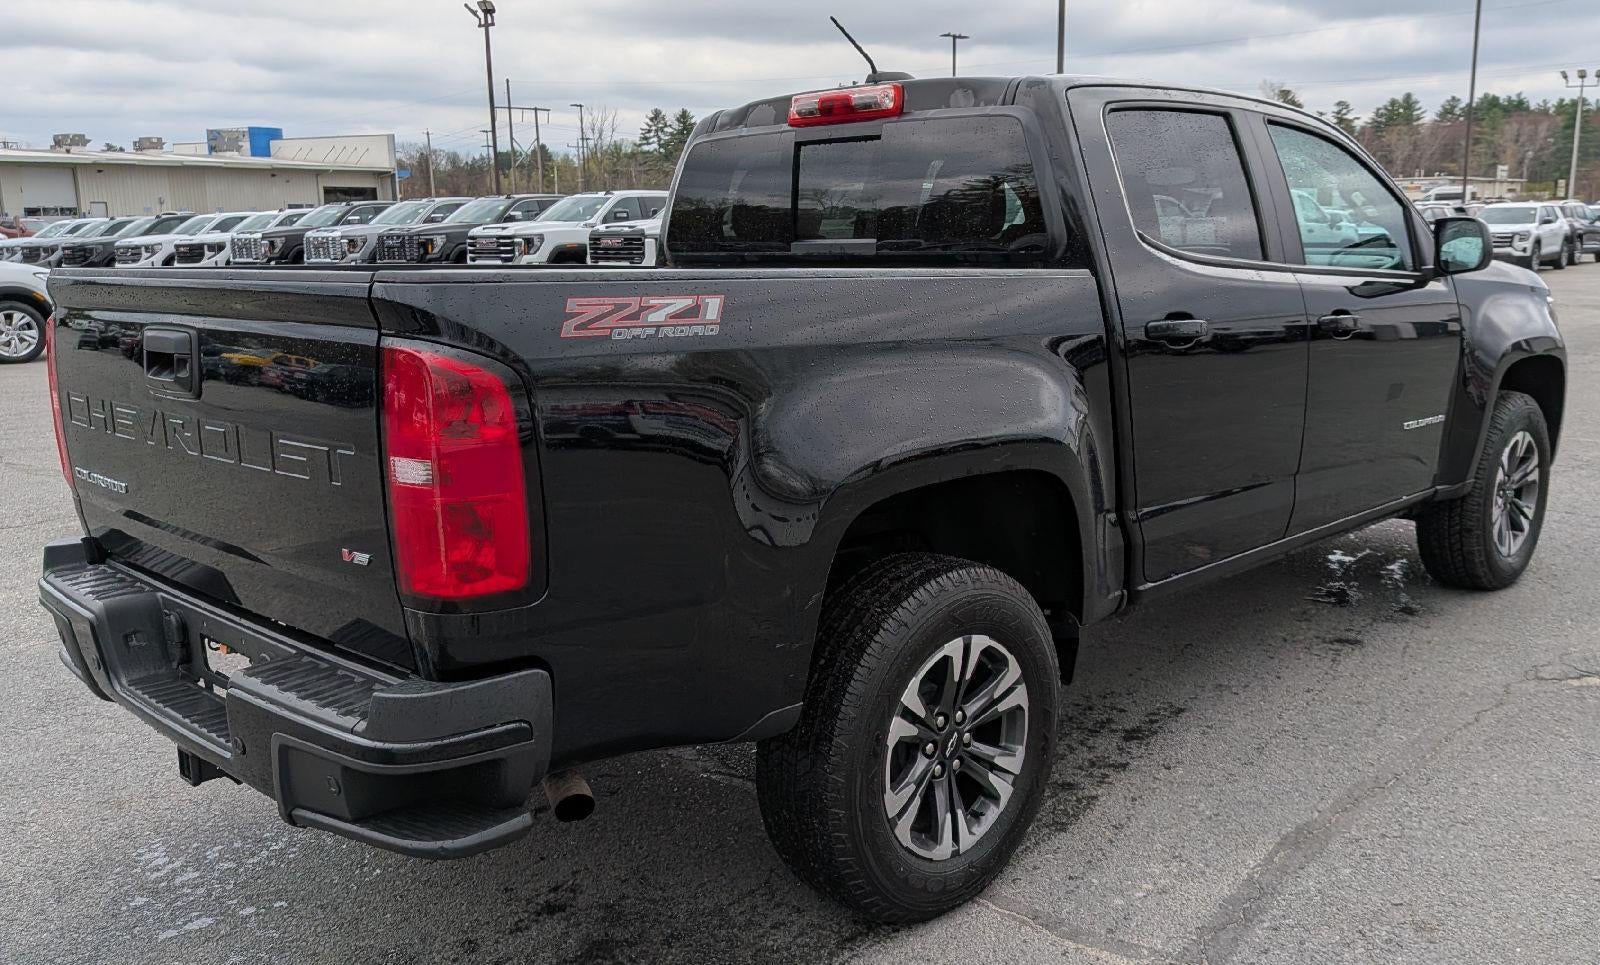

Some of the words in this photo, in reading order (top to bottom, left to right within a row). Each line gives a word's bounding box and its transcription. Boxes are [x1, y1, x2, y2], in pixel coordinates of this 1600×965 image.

[560, 295, 725, 338] Z71
[611, 327, 658, 340] OFF
[658, 324, 720, 338] ROAD
[1403, 414, 1446, 430] COLORADO
[67, 390, 356, 486] CHEVROLET
[74, 466, 129, 494] COLORADO
[341, 548, 370, 566] V6
